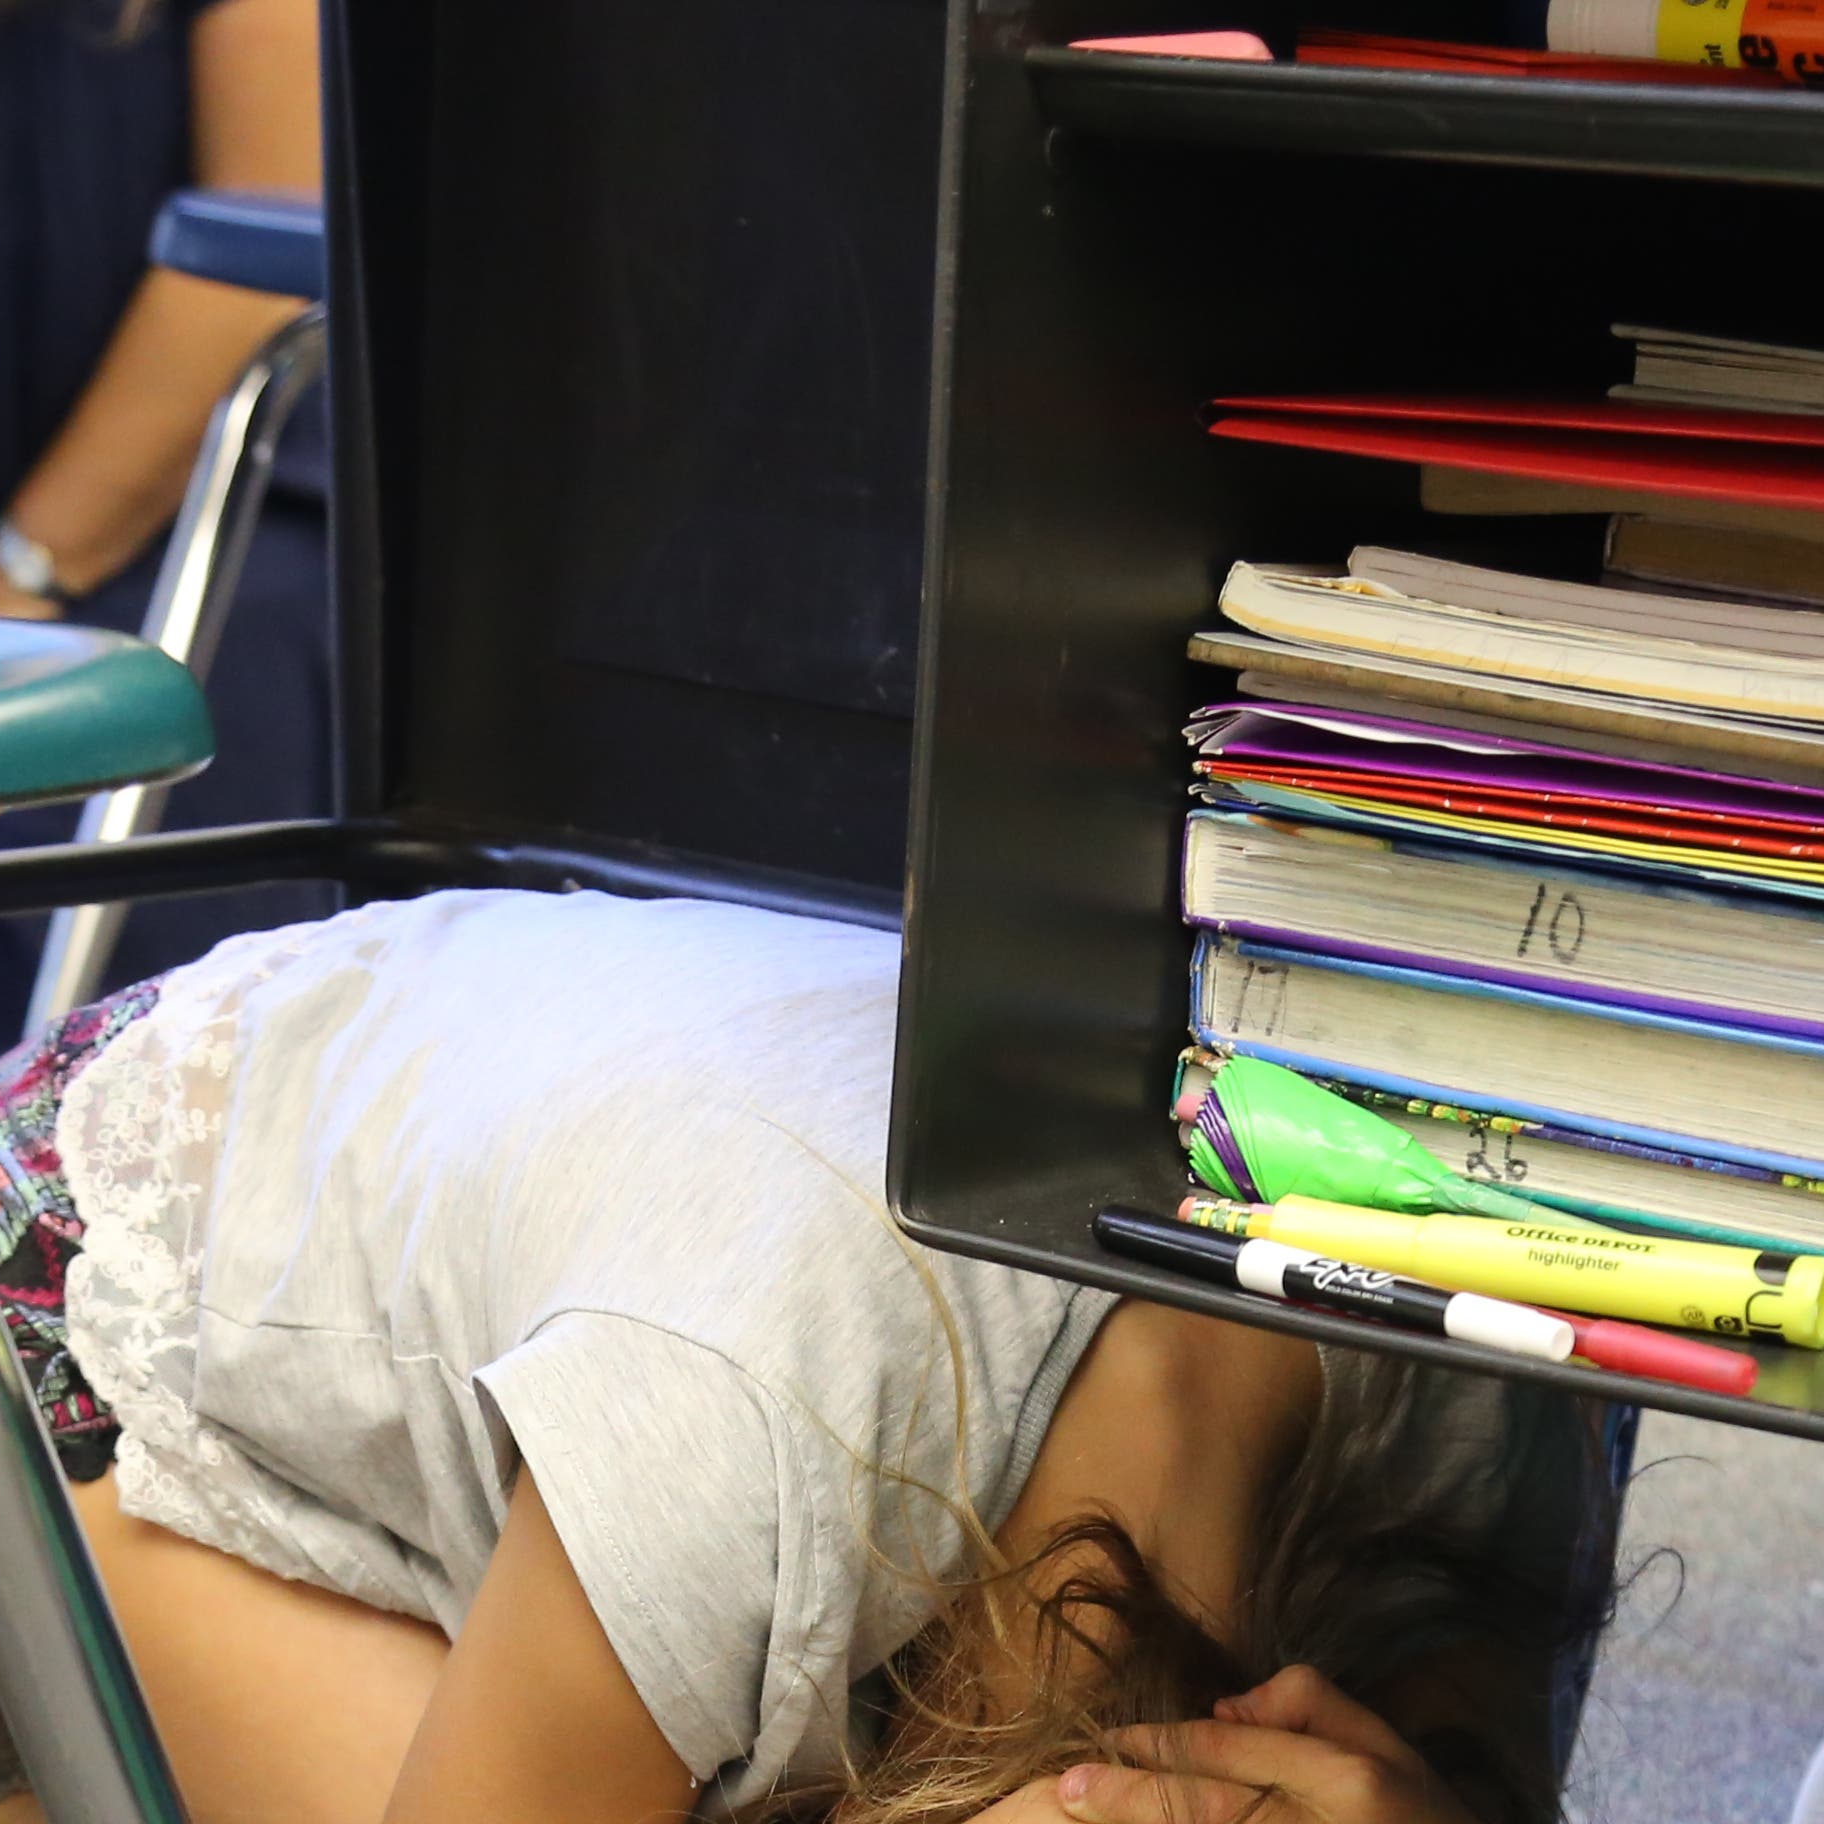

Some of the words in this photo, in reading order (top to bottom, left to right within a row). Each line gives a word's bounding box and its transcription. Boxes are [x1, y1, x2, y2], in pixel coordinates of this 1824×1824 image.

[1517, 883, 1584, 964] 10
[1507, 1227, 1579, 1243] Office
[1583, 1238, 1656, 1252] DEPOT
[1527, 1248, 1621, 1271] highlighter
